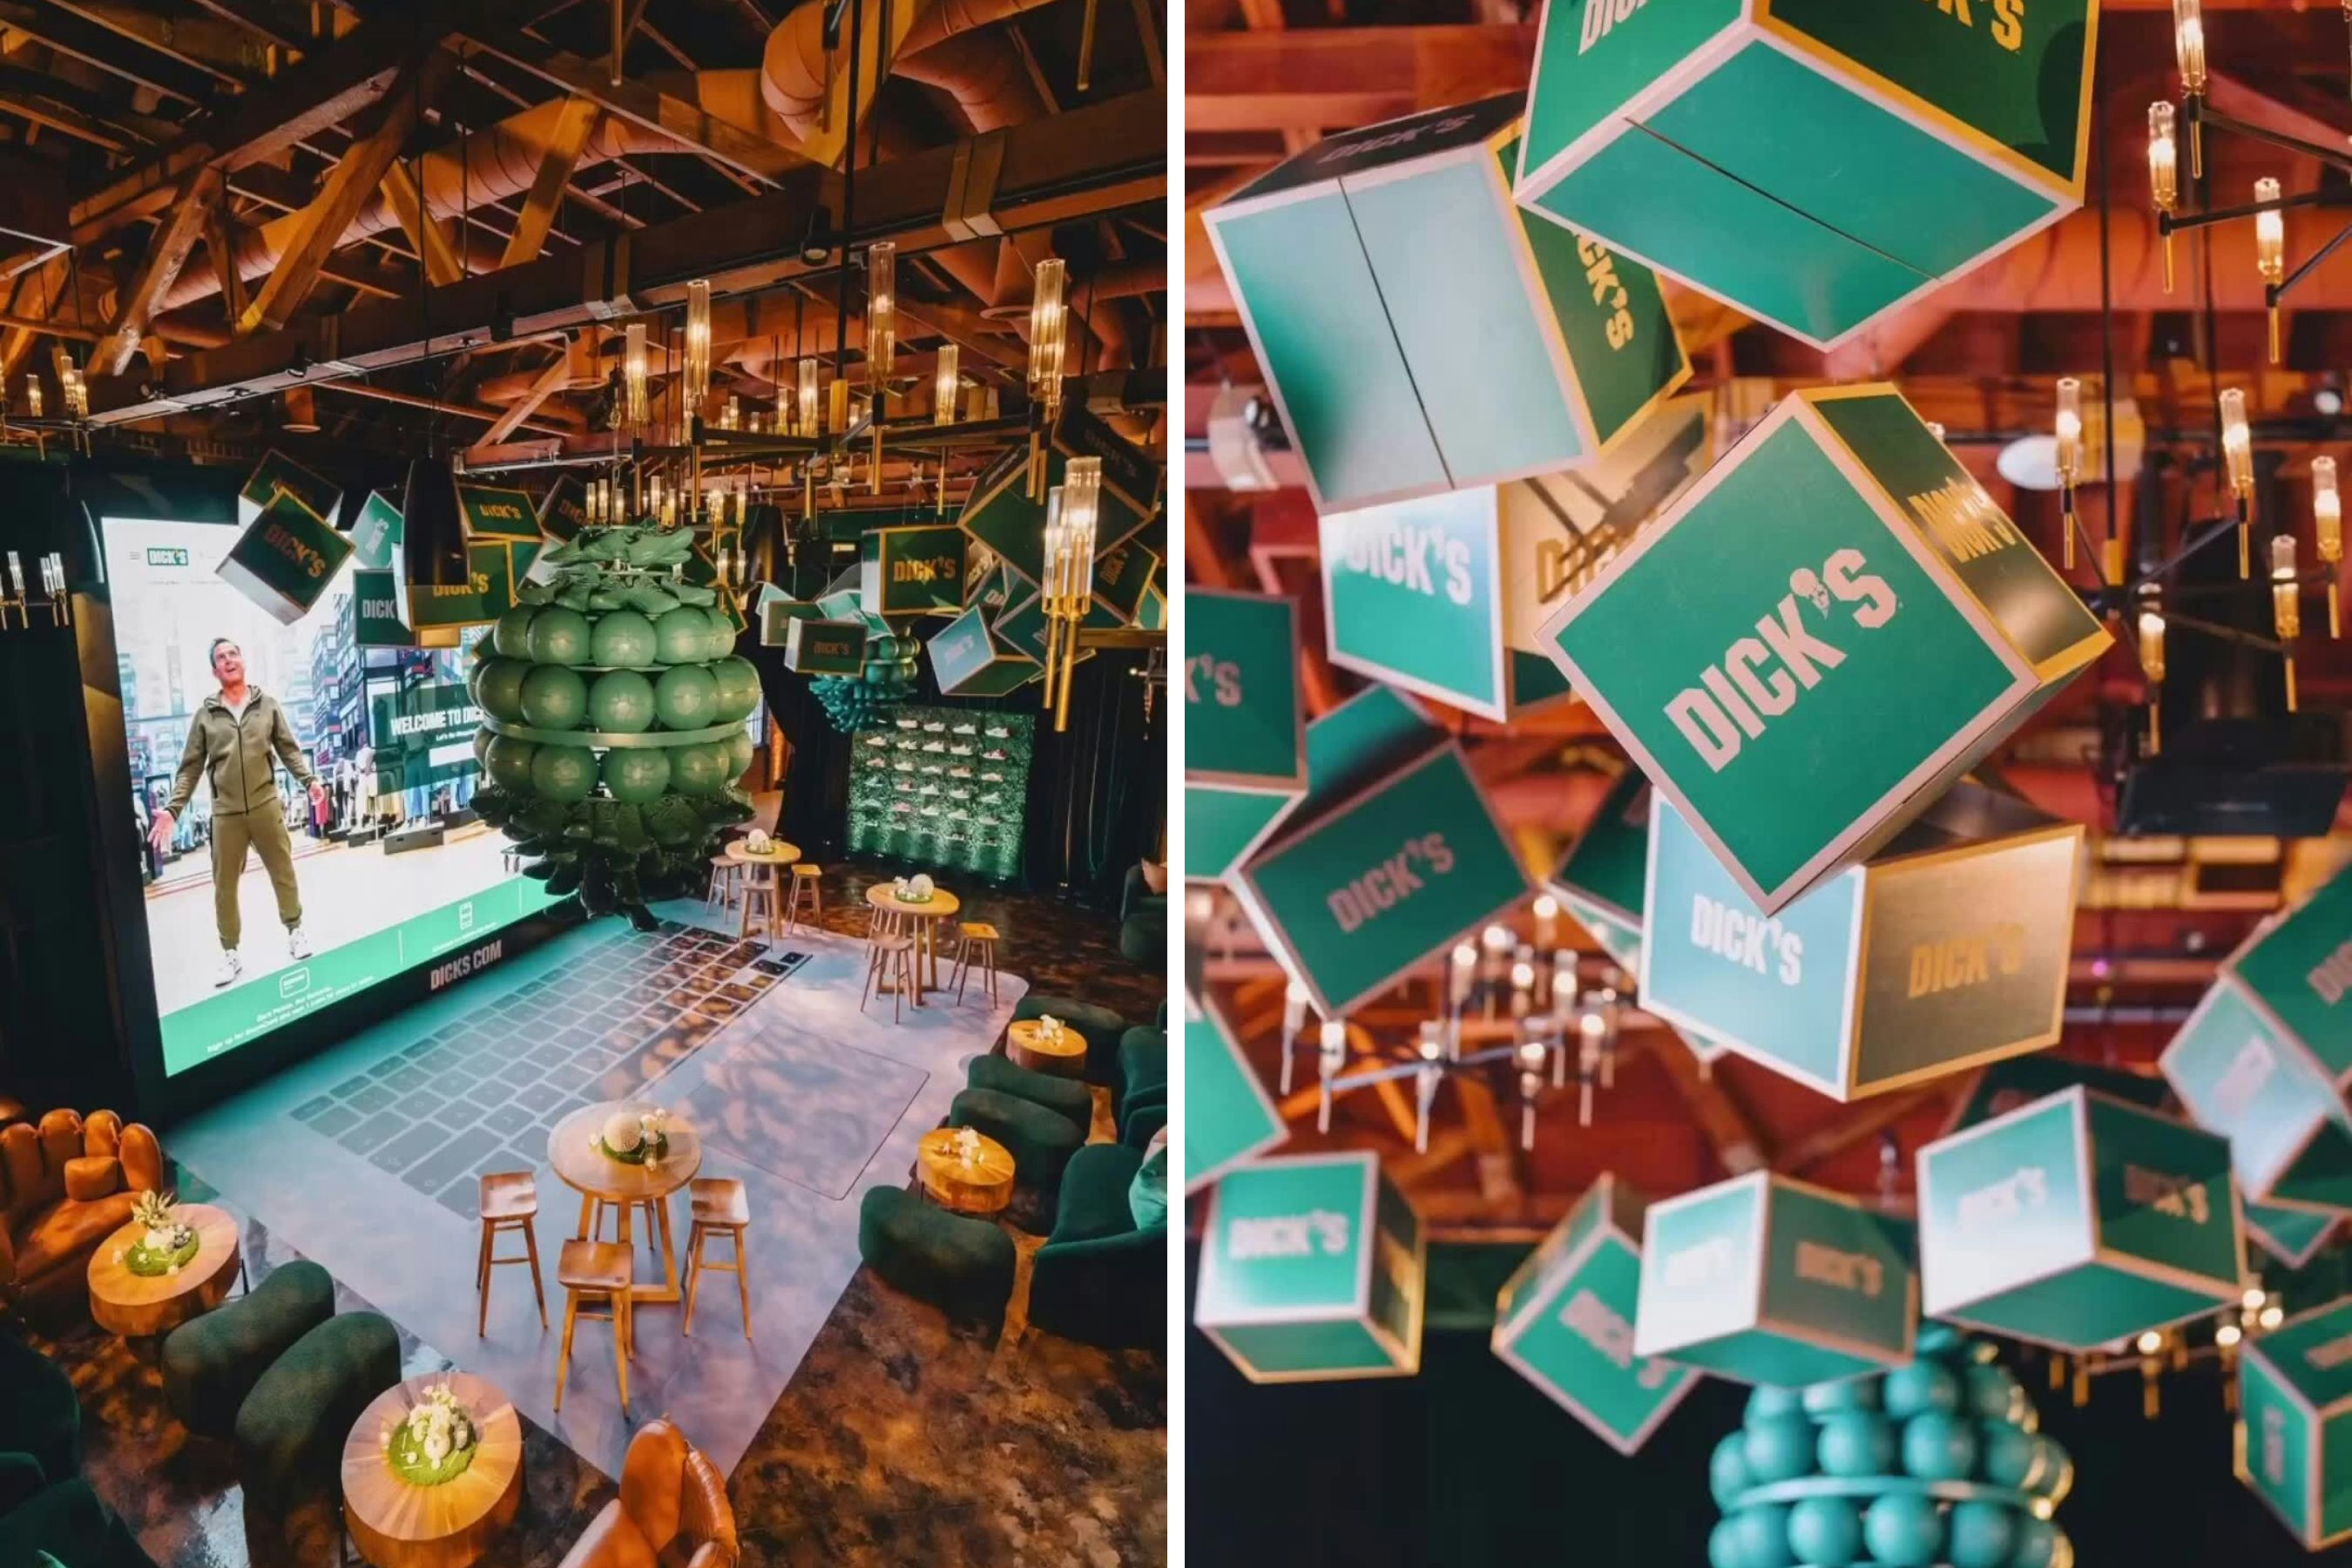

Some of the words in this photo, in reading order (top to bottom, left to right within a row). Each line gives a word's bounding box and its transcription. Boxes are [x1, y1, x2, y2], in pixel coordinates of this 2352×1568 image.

[892, 556, 956, 583] DICK'S
[362, 598, 397, 619] DICK
[1663, 547, 1897, 774] DICK'S
[390, 711, 447, 737] WELCOME
[448, 707, 462, 727] TO
[1327, 831, 1456, 935] DICK'S
[1690, 893, 1803, 987] DICK'S
